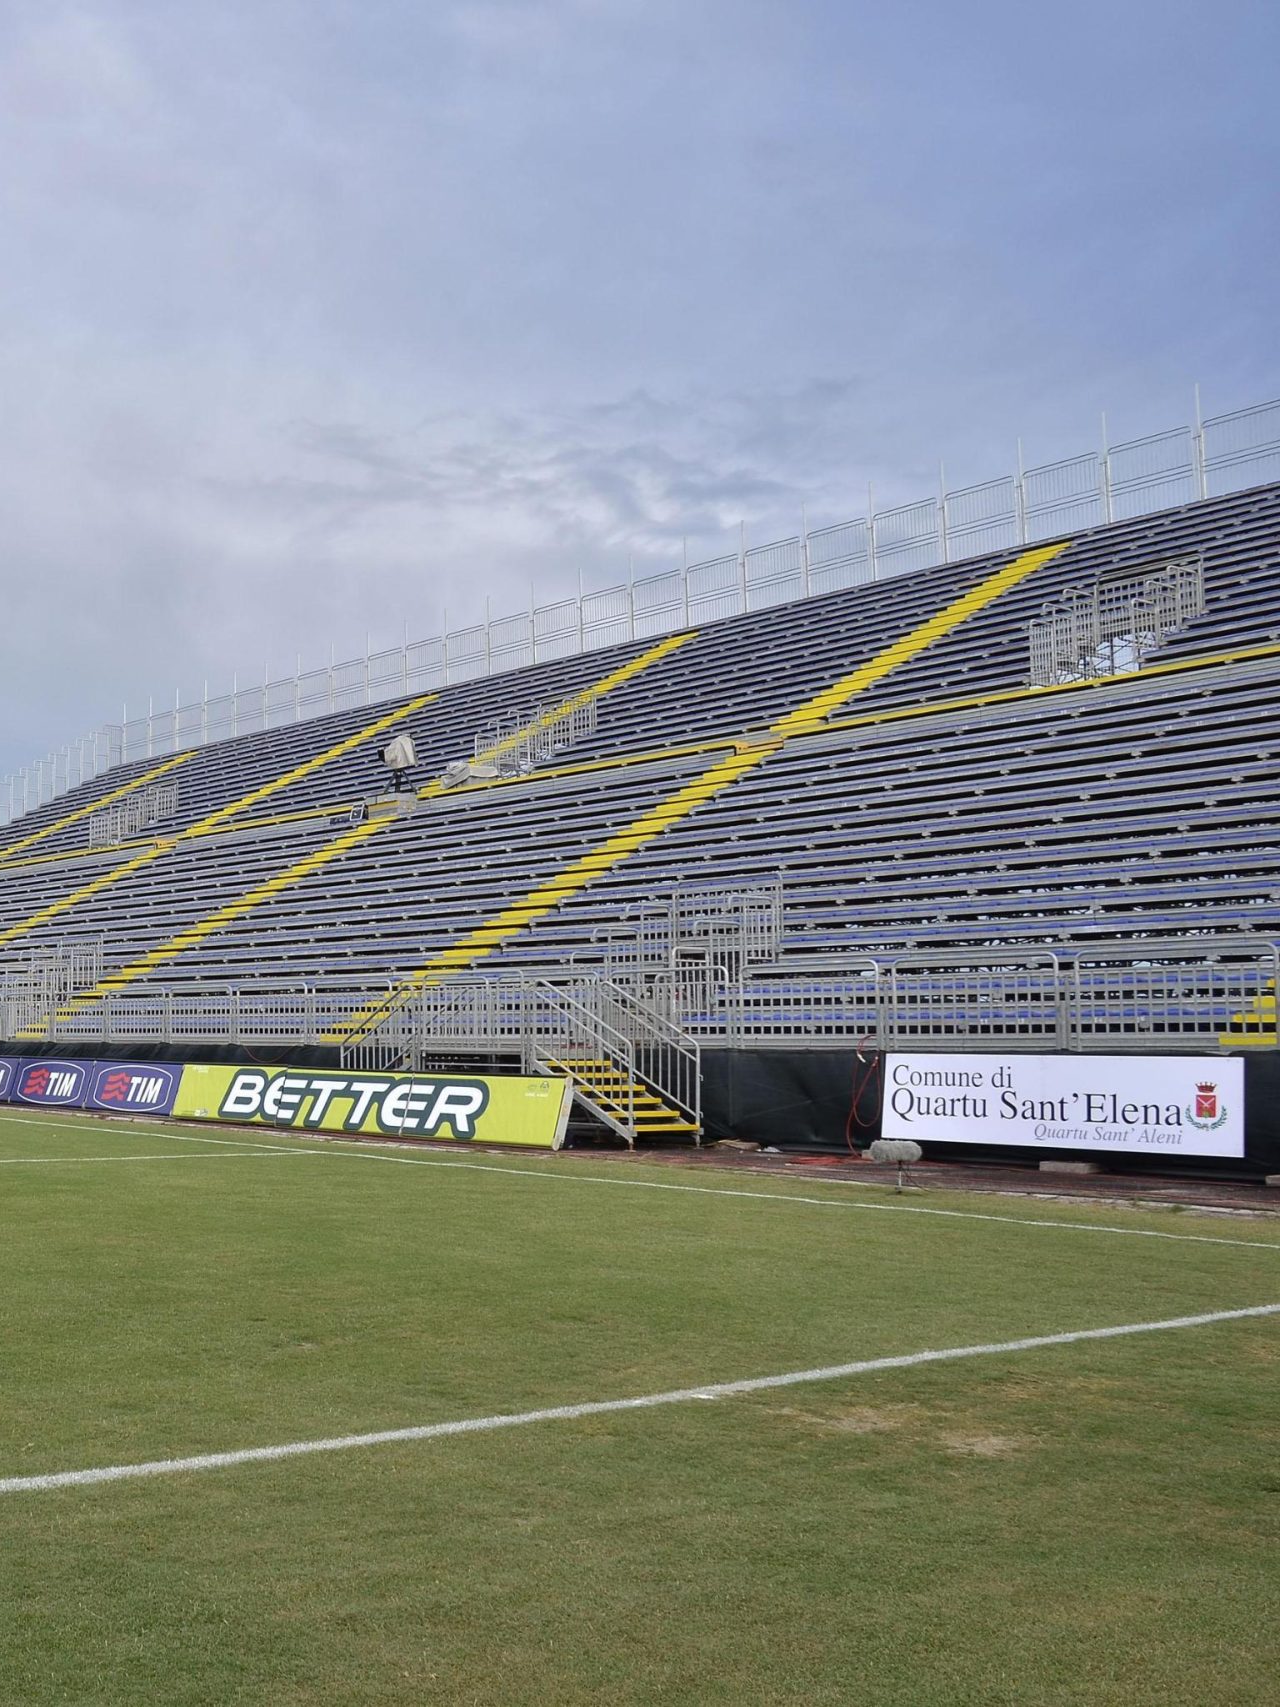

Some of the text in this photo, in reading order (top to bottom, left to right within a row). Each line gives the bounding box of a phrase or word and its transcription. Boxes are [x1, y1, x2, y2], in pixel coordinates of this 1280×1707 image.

[45, 1071, 78, 1097] TIM
[126, 1076, 164, 1103] TIM
[892, 1064, 1013, 1089] Comune di
[220, 1071, 486, 1135] BETTER
[891, 1087, 1183, 1126] Quartu Sant'Elena
[1034, 1123, 1088, 1141] Quartu
[1137, 1128, 1183, 1145] Aleni
